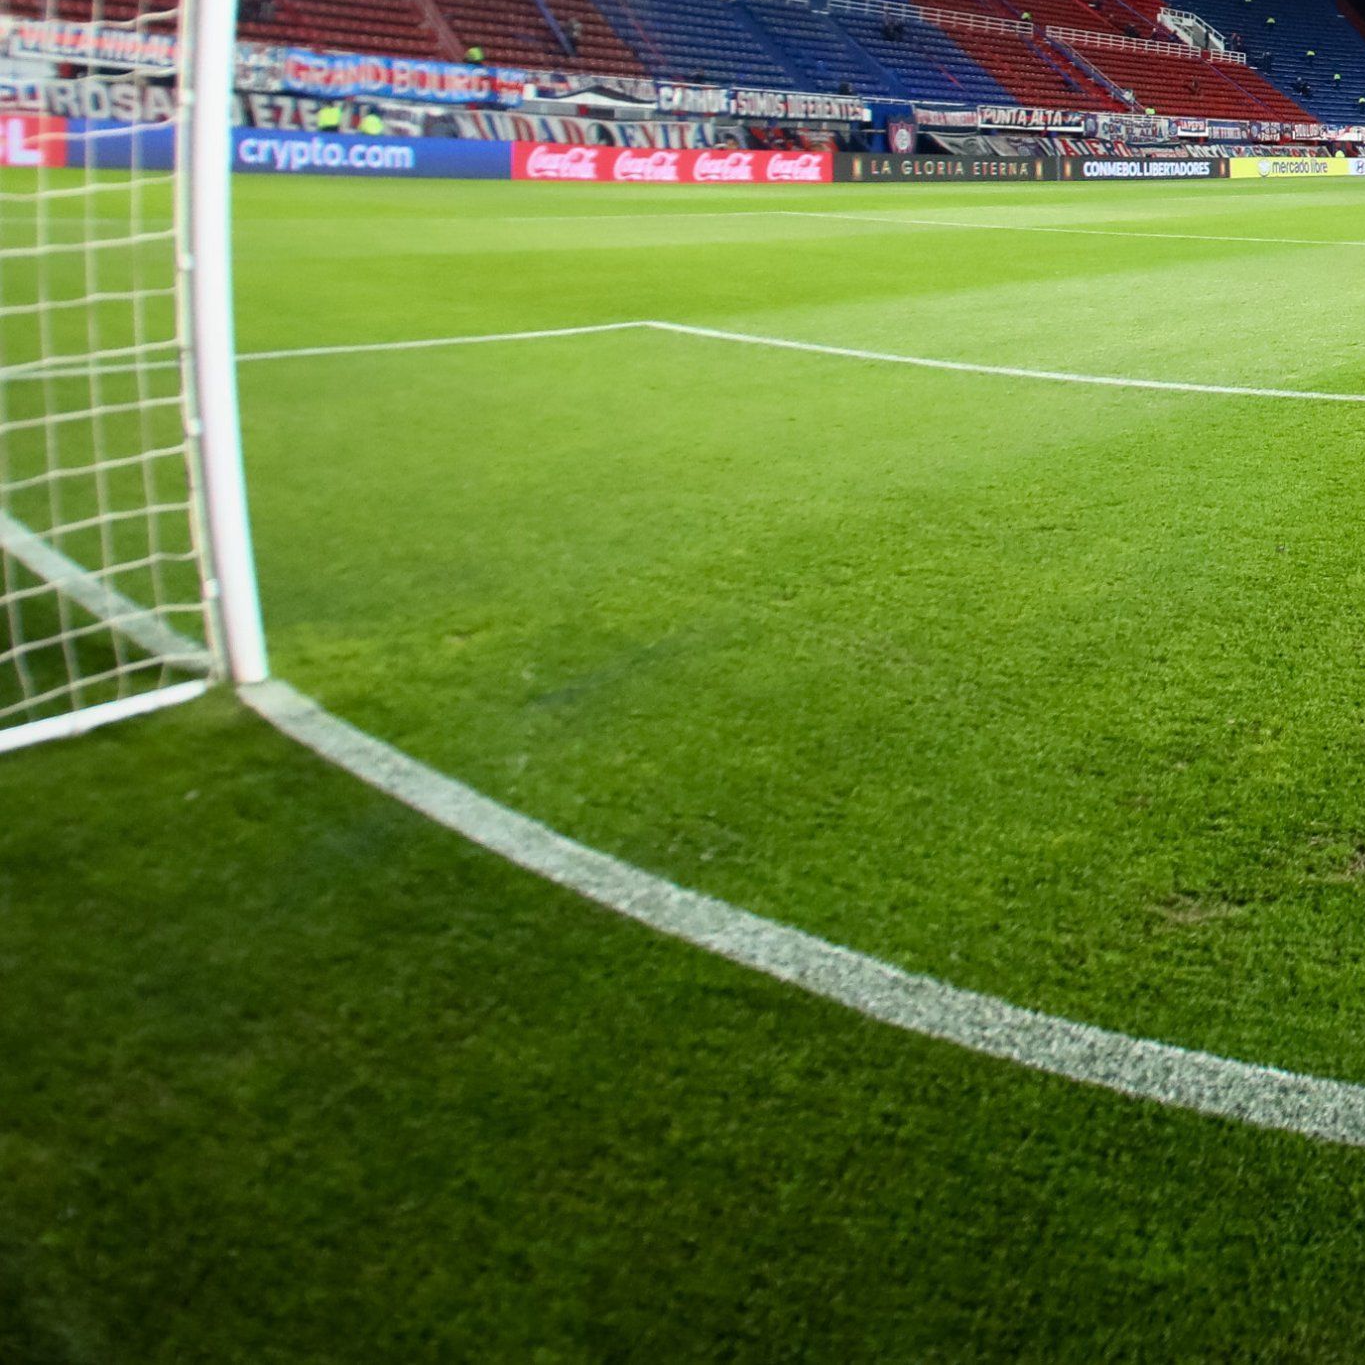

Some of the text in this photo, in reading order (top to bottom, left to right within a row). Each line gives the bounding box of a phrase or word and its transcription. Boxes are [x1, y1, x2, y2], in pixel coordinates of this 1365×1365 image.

[982, 108, 1026, 125] PUNTA
[1027, 111, 1062, 126] ALTA
[238, 137, 415, 171] crypto.com
[870, 160, 1029, 176] LA GLORIA ETERNA
[1082, 161, 1211, 177] CONMEBOL LIBERTADORES
[1272, 158, 1328, 175] mercado libre
